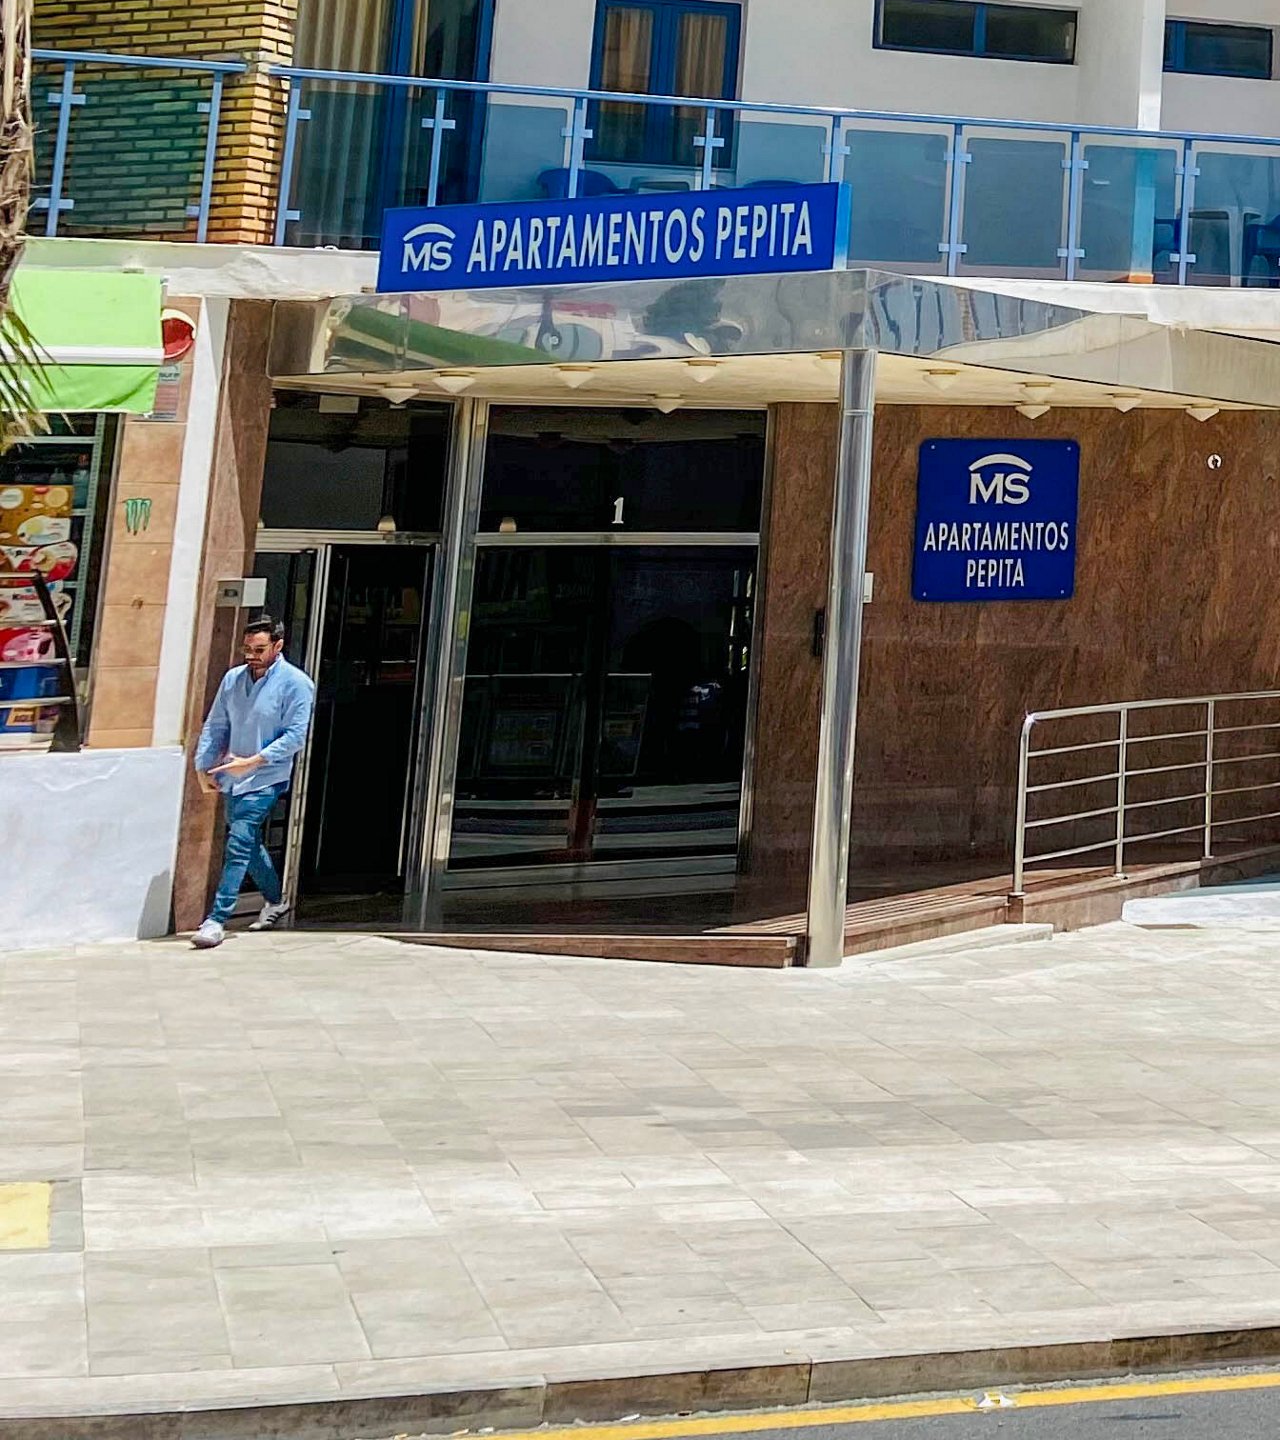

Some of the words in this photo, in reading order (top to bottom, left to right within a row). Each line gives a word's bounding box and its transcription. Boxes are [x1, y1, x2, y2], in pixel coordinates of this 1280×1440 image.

[401, 242, 453, 272] MS
[466, 207, 705, 273] APARTAMENTOS
[714, 201, 813, 260] PEPITA
[969, 473, 1030, 504] MS
[612, 496, 624, 524] 1
[923, 521, 1069, 551] APARTAMENTOS
[966, 558, 1025, 588] PEPITA
